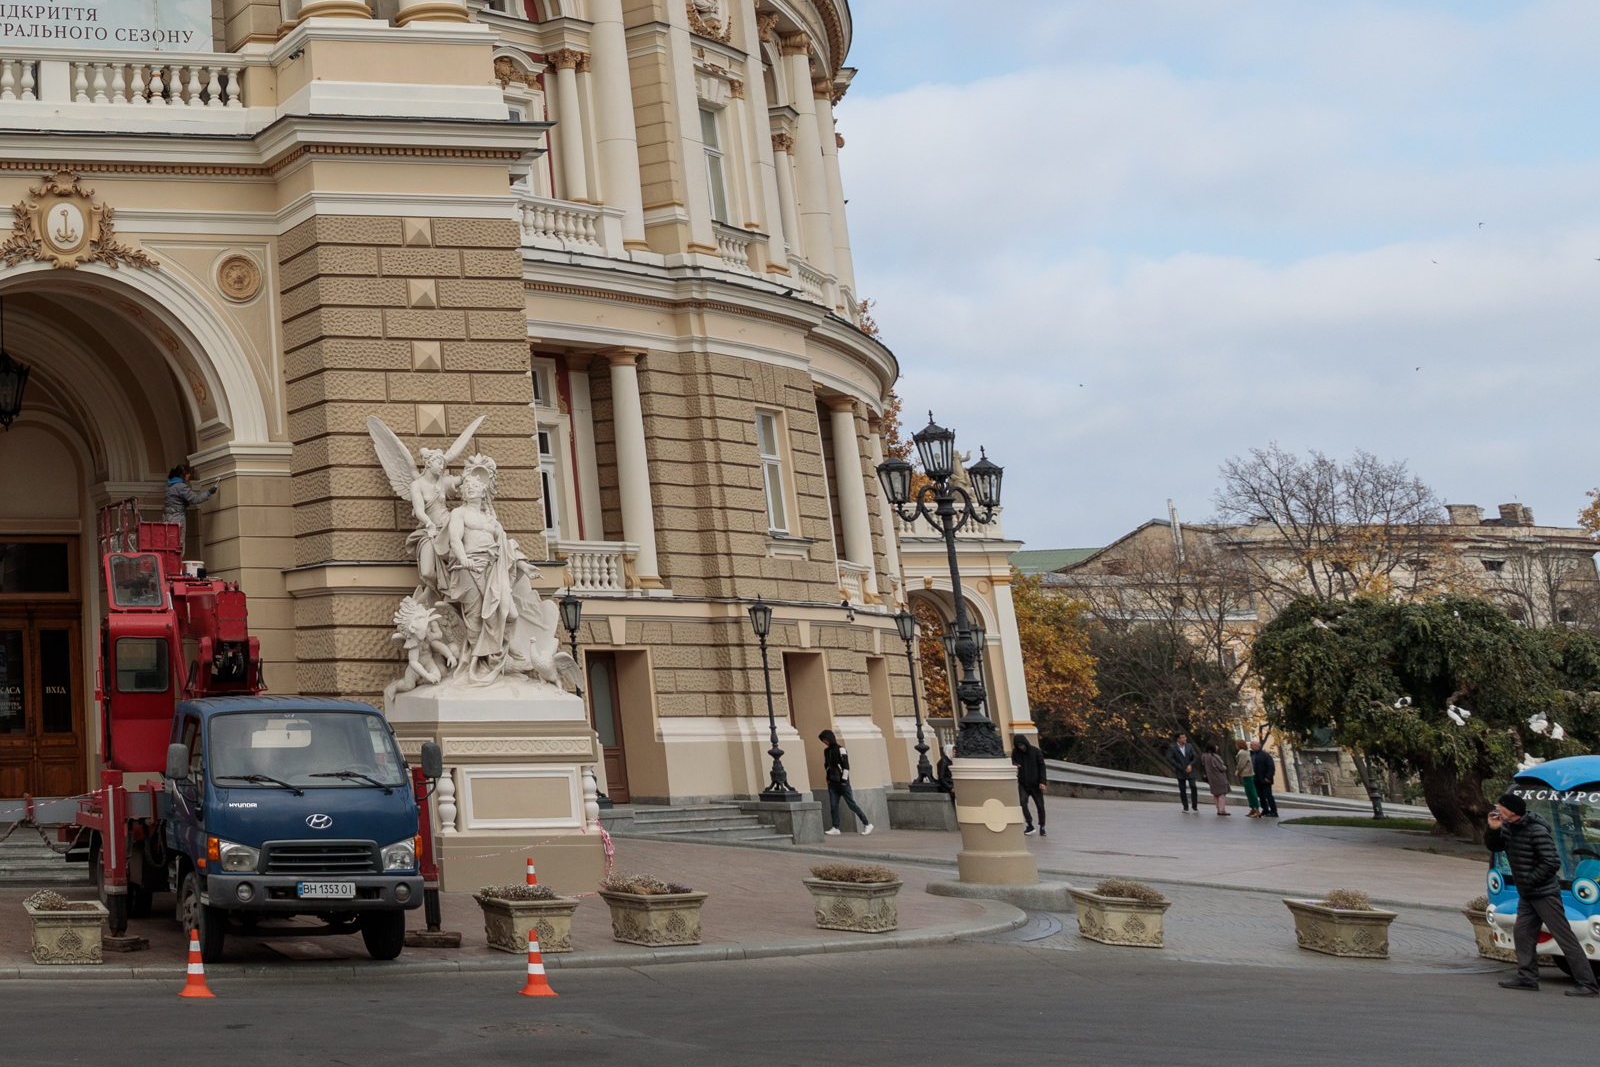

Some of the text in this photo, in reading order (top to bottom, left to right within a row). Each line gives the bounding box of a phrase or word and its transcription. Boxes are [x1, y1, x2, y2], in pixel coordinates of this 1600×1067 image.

[114, 28, 194, 44] СЕЗОНУ
[45, 686, 67, 694] ВХІД
[303, 884, 317, 894] BH
[318, 884, 340, 894] 1353
